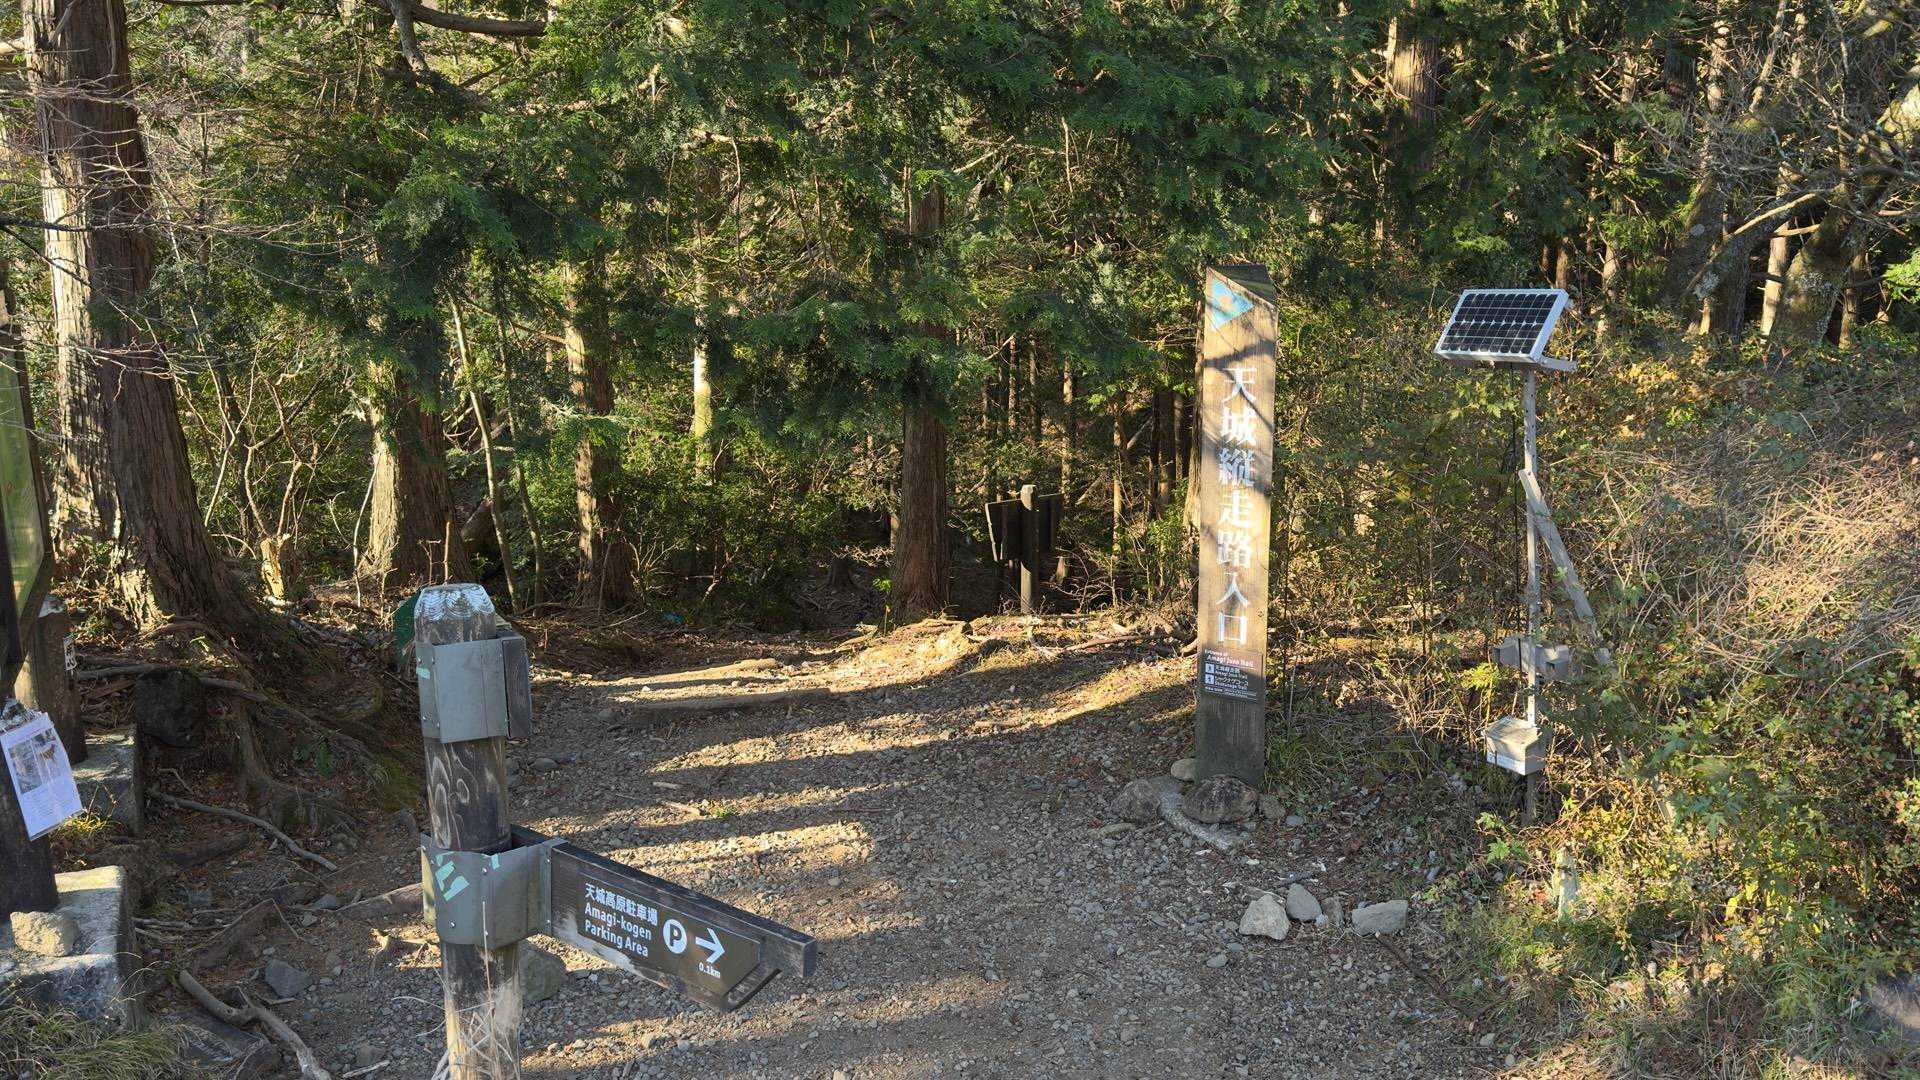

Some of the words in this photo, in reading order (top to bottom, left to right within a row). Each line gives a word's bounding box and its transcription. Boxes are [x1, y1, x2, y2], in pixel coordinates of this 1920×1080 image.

[1216, 367, 1258, 646] 天城縦走路入口
[584, 902, 652, 940] Amagi-kogen
[585, 882, 658, 926] 天城高原駐車場
[584, 919, 623, 949] Parking
[625, 936, 649, 957] Area
[698, 961, 721, 979] 0.1km
